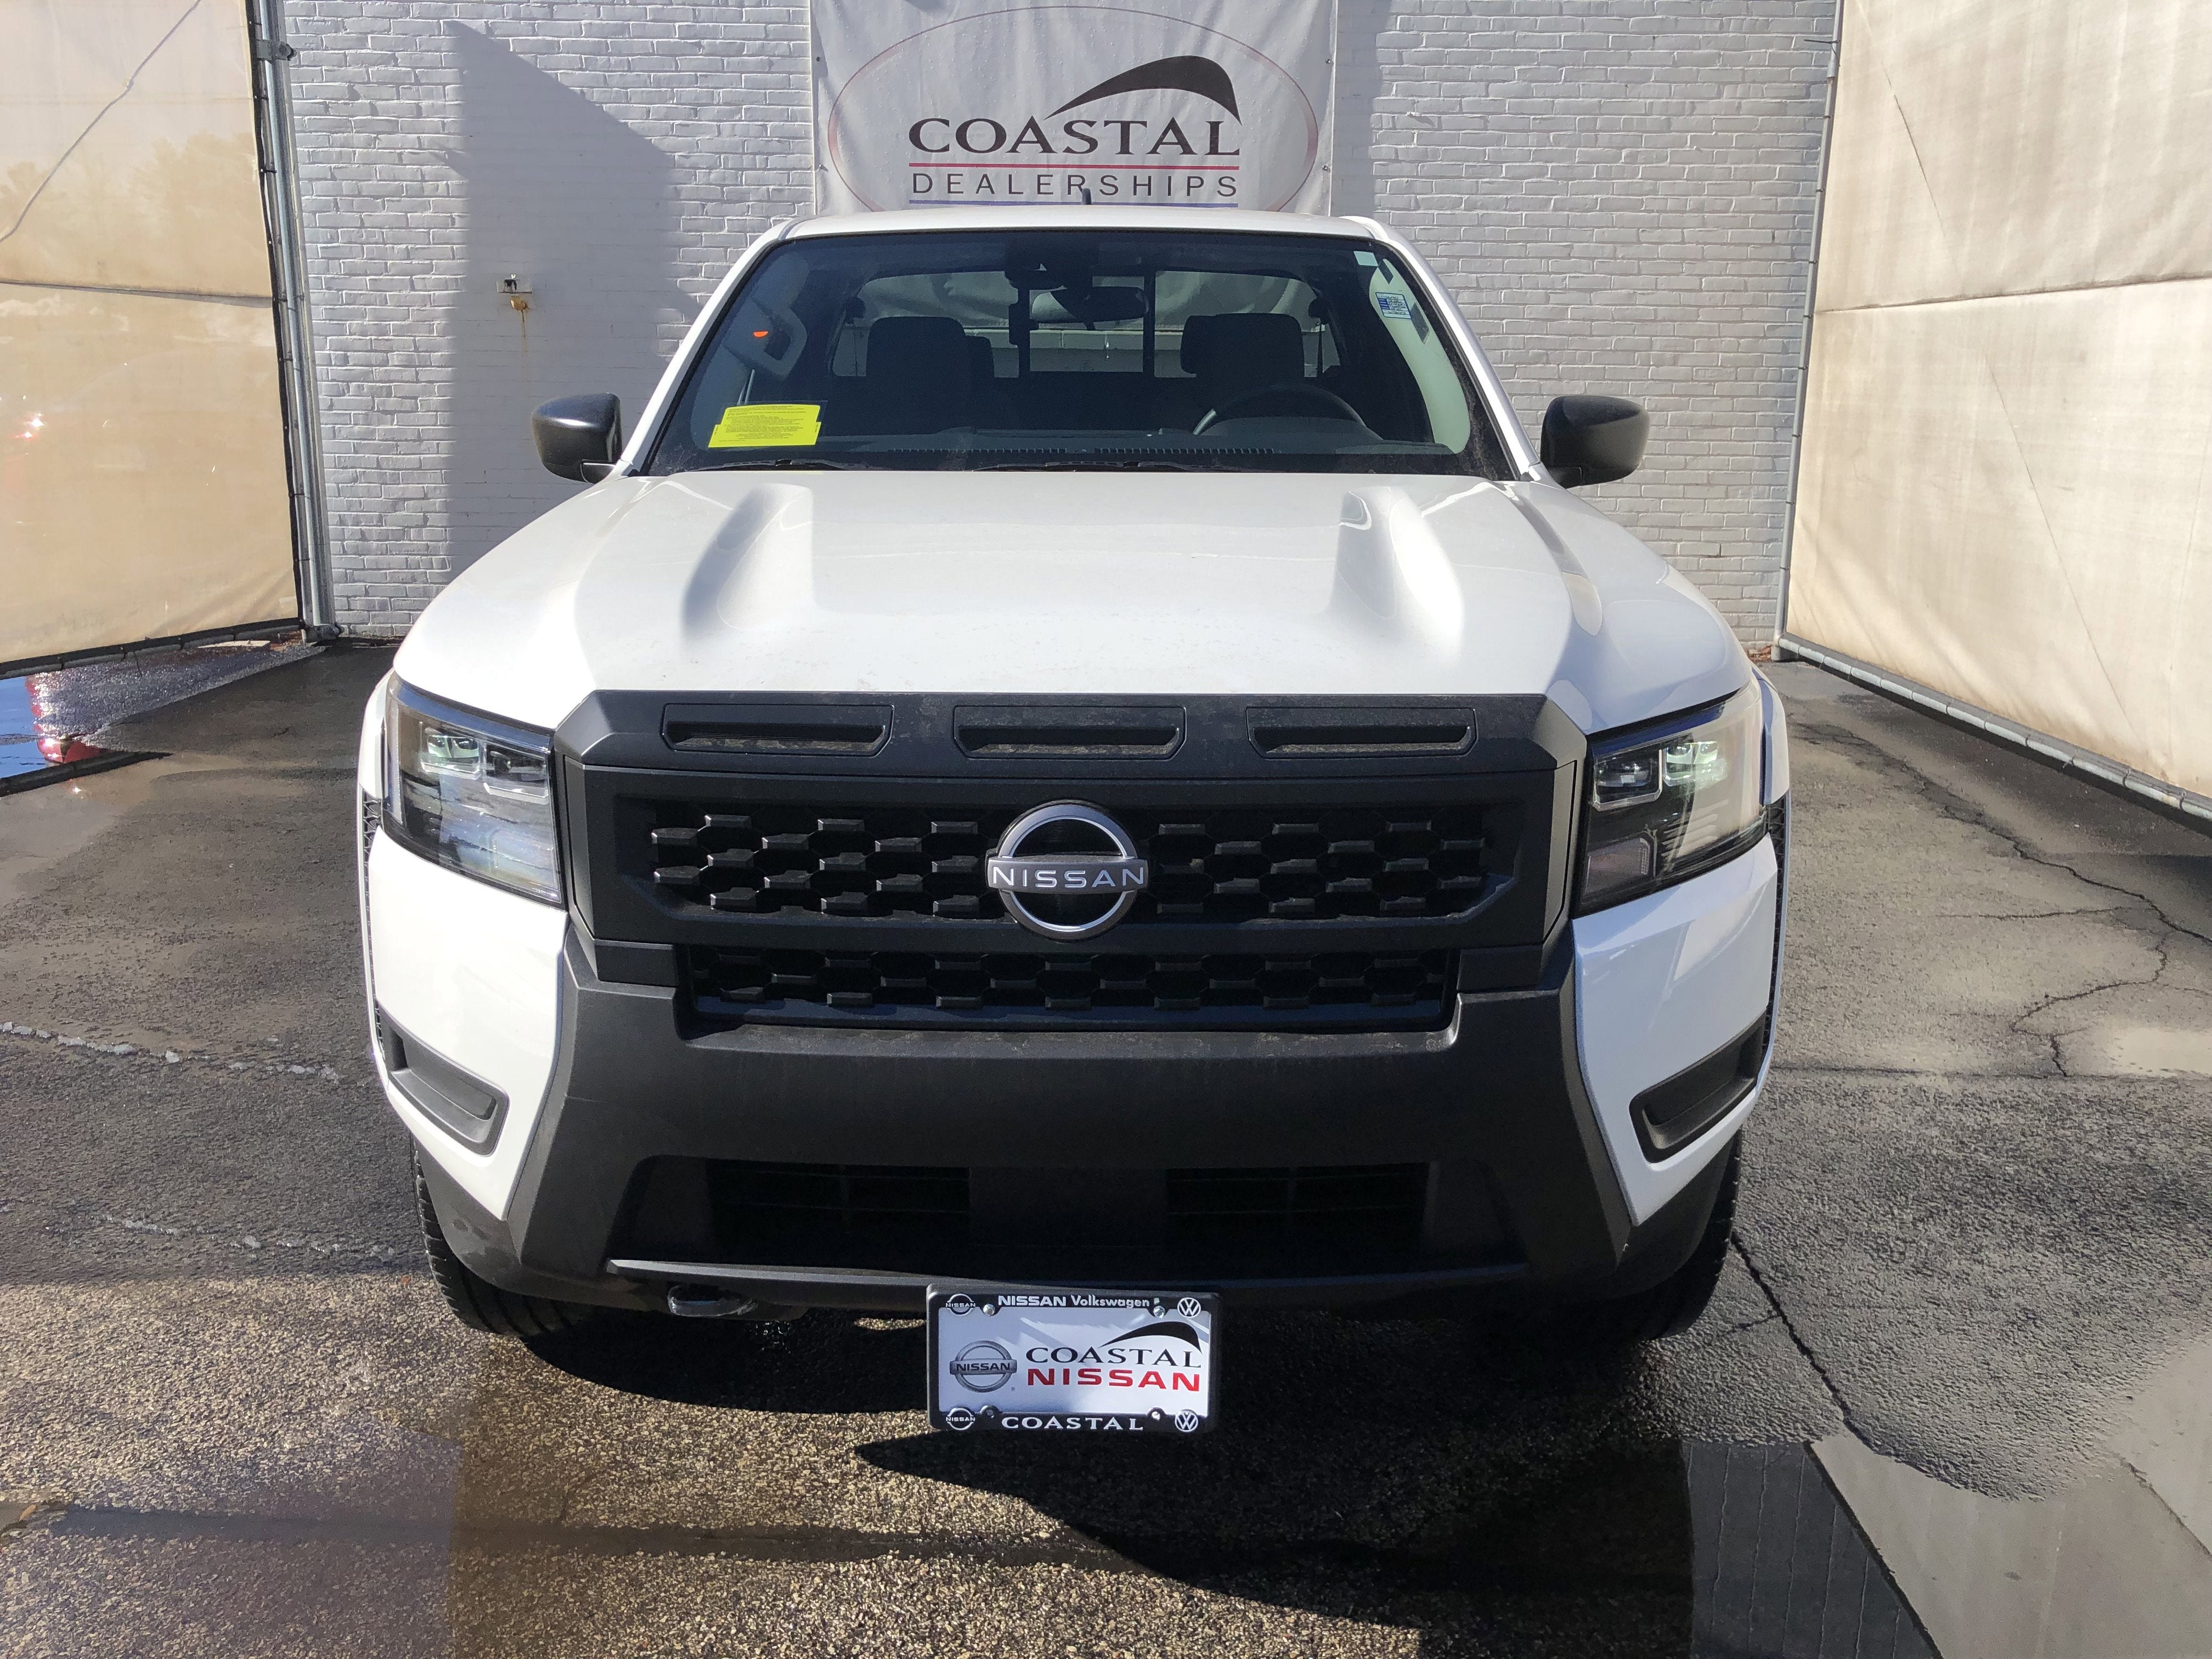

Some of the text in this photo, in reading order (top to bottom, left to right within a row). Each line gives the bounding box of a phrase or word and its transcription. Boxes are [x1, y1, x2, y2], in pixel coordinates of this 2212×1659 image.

[908, 115, 1241, 156] COASTAL
[912, 172, 1238, 198] DEALERSHIPS
[992, 866, 1144, 888] NISSAN
[998, 1294, 1150, 1309] NISSAN Volkswagen
[956, 1362, 1011, 1372] NISSAN
[1025, 1346, 1202, 1368] COASTAL
[1026, 1367, 1200, 1392] NISSAN
[1001, 1415, 1143, 1430] COASTAL
